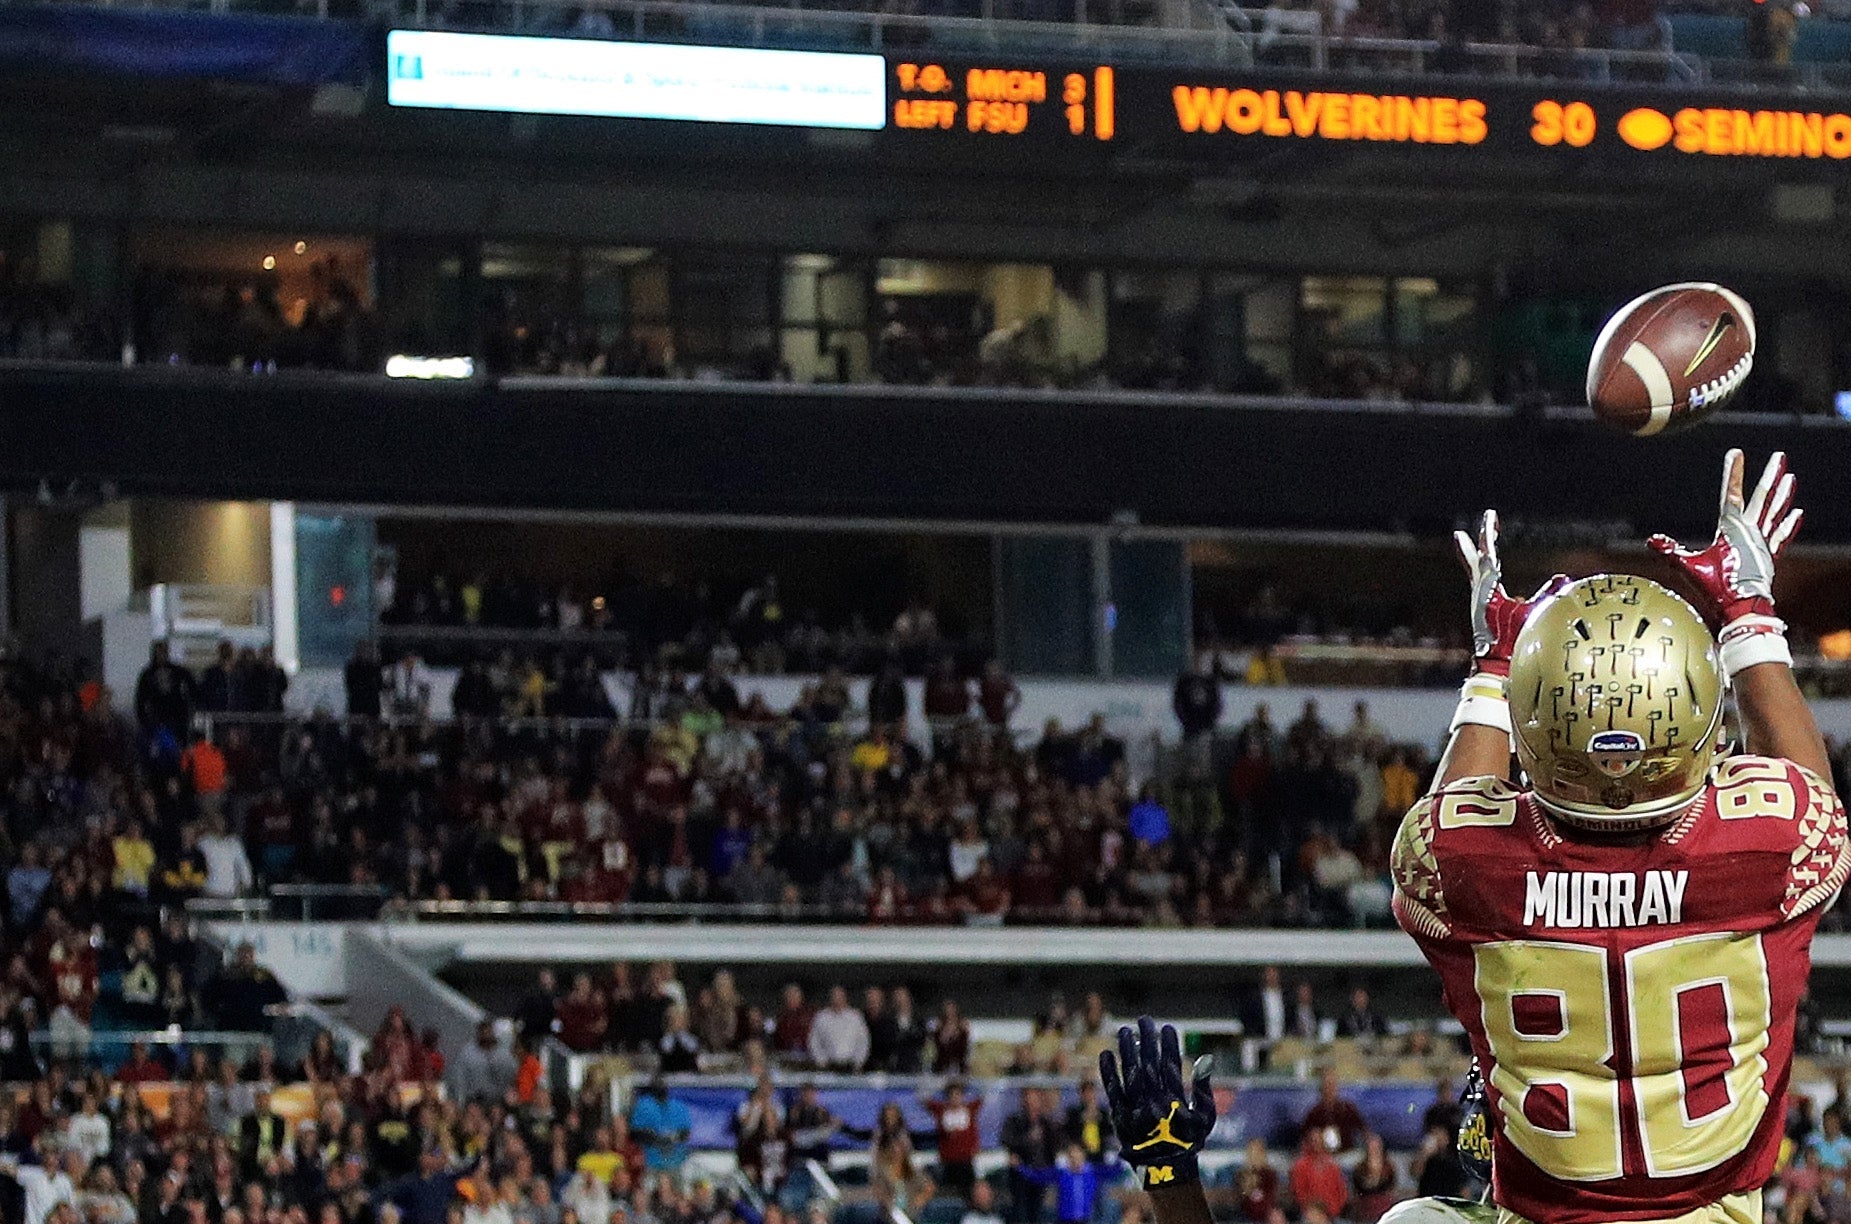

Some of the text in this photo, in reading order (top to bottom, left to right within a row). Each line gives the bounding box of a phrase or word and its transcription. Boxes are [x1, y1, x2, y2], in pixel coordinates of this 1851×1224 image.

[896, 63, 952, 93] T.O.
[966, 68, 1046, 102] MICH
[894, 99, 958, 129] LEFT
[966, 101, 1029, 134] FSU
[1173, 85, 1488, 144] WOLVERINES
[1531, 100, 1597, 147] 30
[1523, 869, 1690, 928] MURRAY
[1471, 931, 1771, 1182] 80
[1147, 1165, 1175, 1186] M
